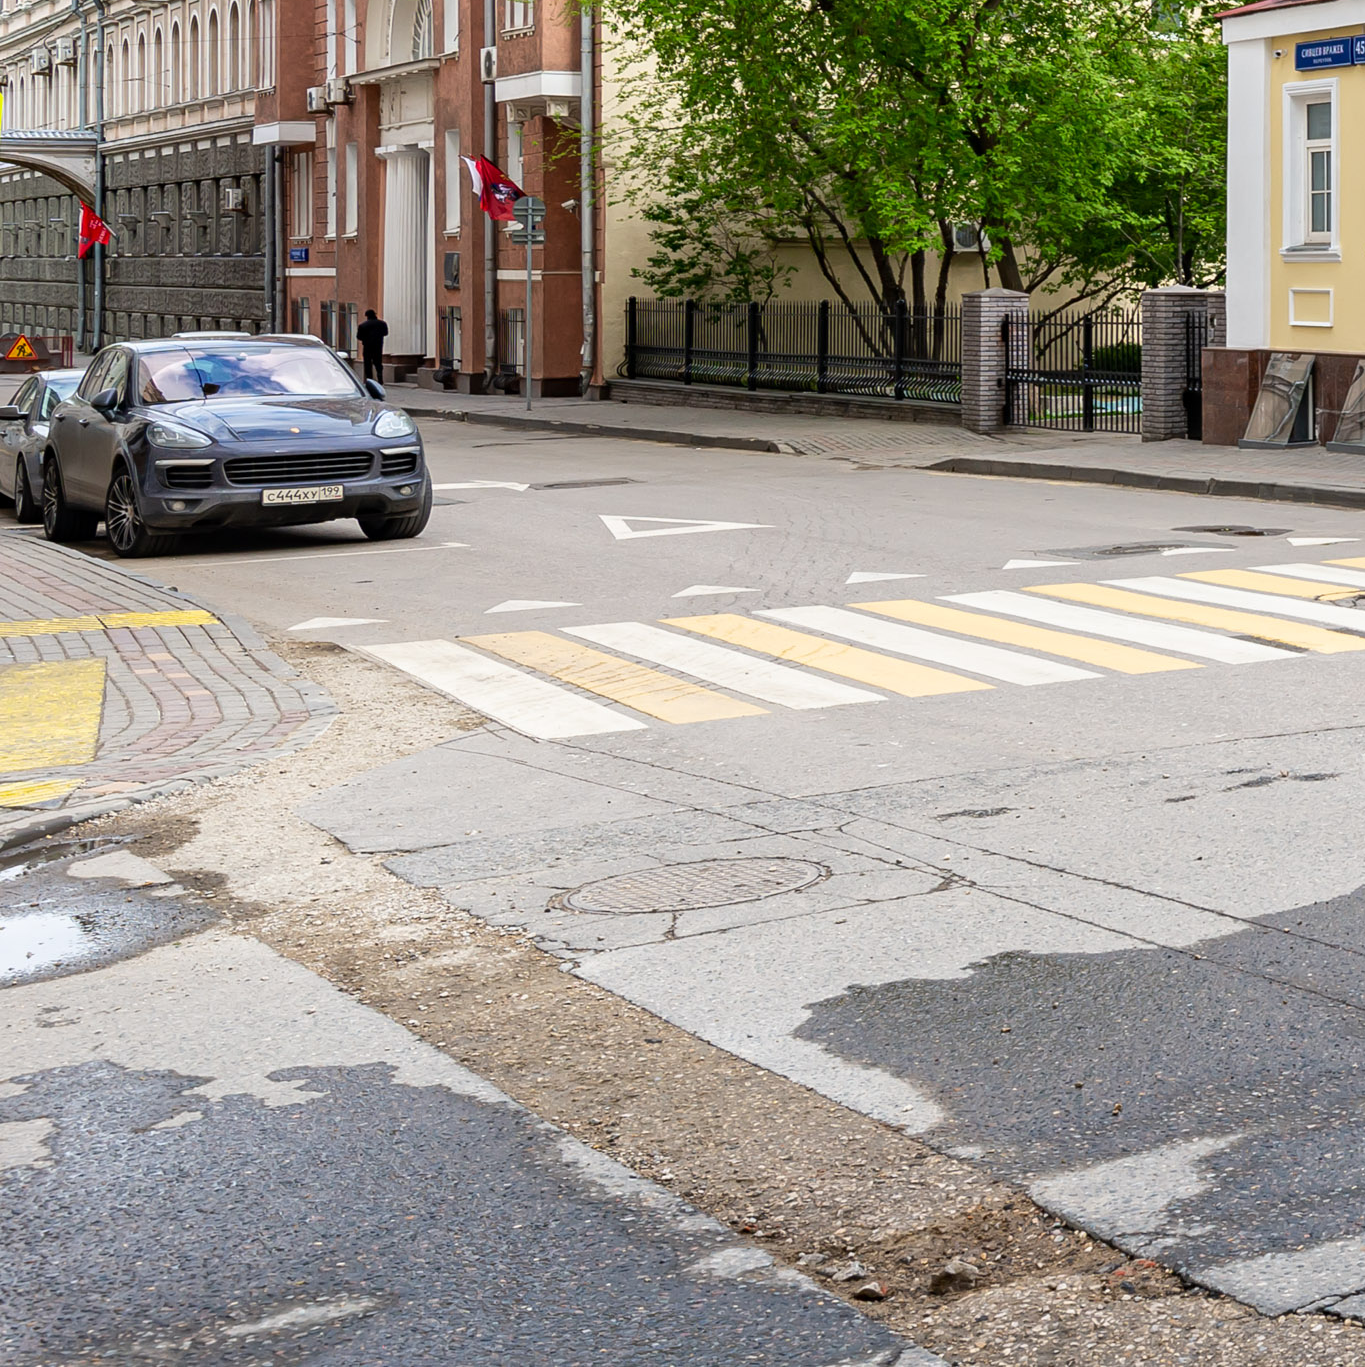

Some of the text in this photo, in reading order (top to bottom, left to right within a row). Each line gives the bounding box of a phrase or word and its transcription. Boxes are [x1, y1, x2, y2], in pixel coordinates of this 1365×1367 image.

[1322, 44, 1344, 56] ВРАЖЕК
[1355, 40, 1365, 55] 45
[320, 486, 340, 496] 199
